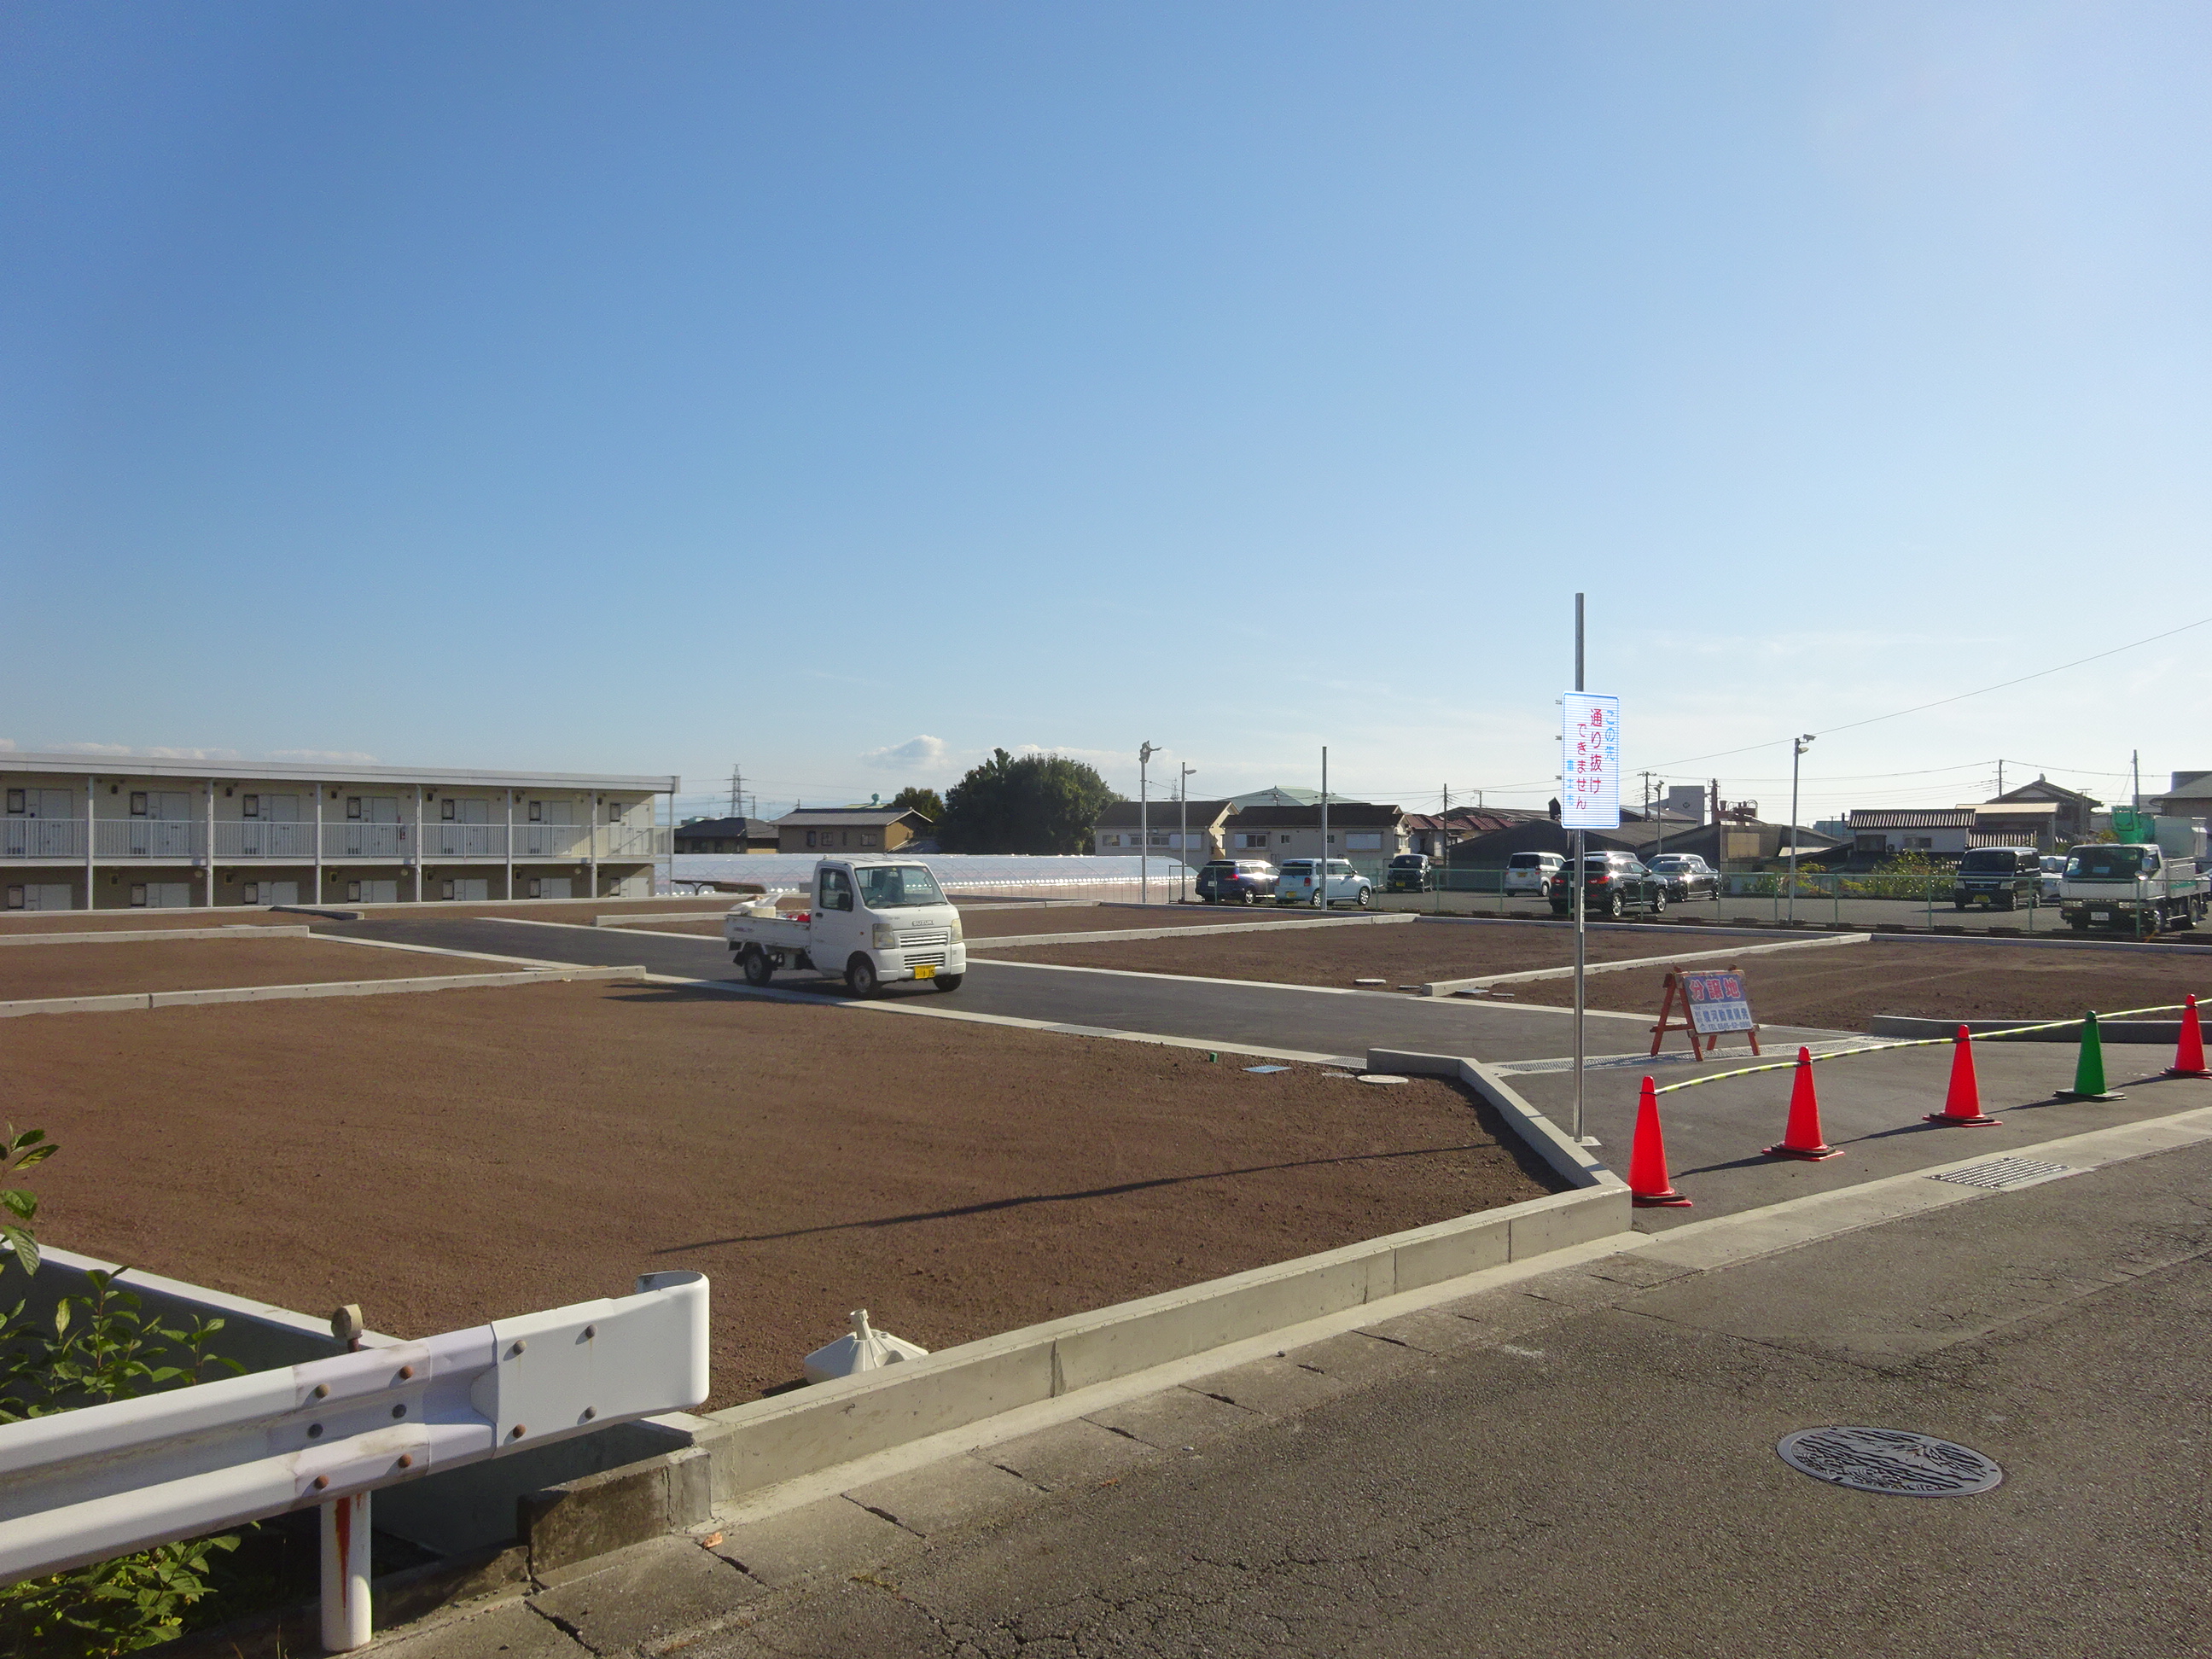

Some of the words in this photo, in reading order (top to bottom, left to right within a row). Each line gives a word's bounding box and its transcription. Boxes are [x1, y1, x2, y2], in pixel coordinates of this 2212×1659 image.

[1576, 723, 1586, 810] できません
[1590, 708, 1603, 794] 通り抜け
[1605, 710, 1615, 760] この先
[1689, 978, 1740, 1000] 分譲地
